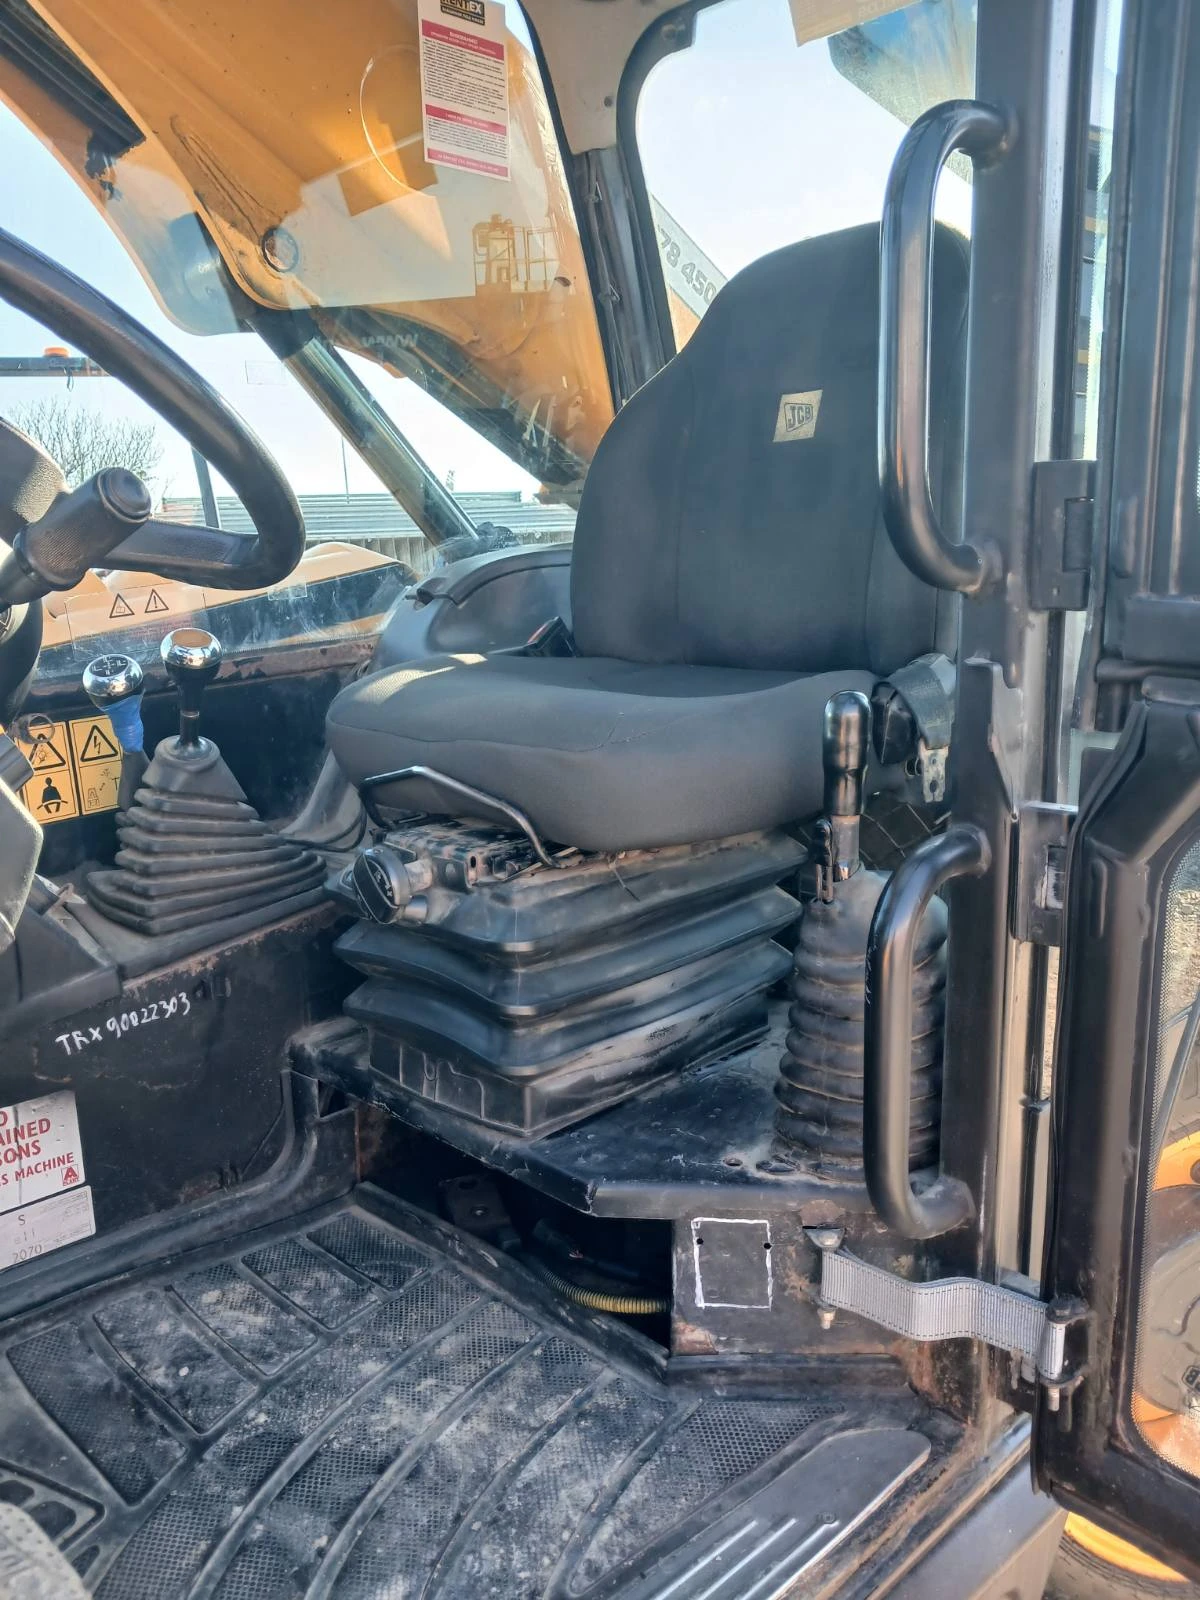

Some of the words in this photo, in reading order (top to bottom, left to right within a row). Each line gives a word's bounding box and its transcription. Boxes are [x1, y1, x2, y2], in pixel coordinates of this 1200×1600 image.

[658, 225, 681, 268] 78
[681, 262, 717, 305] 450
[788, 405, 812, 429] JCB
[0, 1140, 41, 1166] ONS
[15, 1152, 74, 1182] MACHINE
